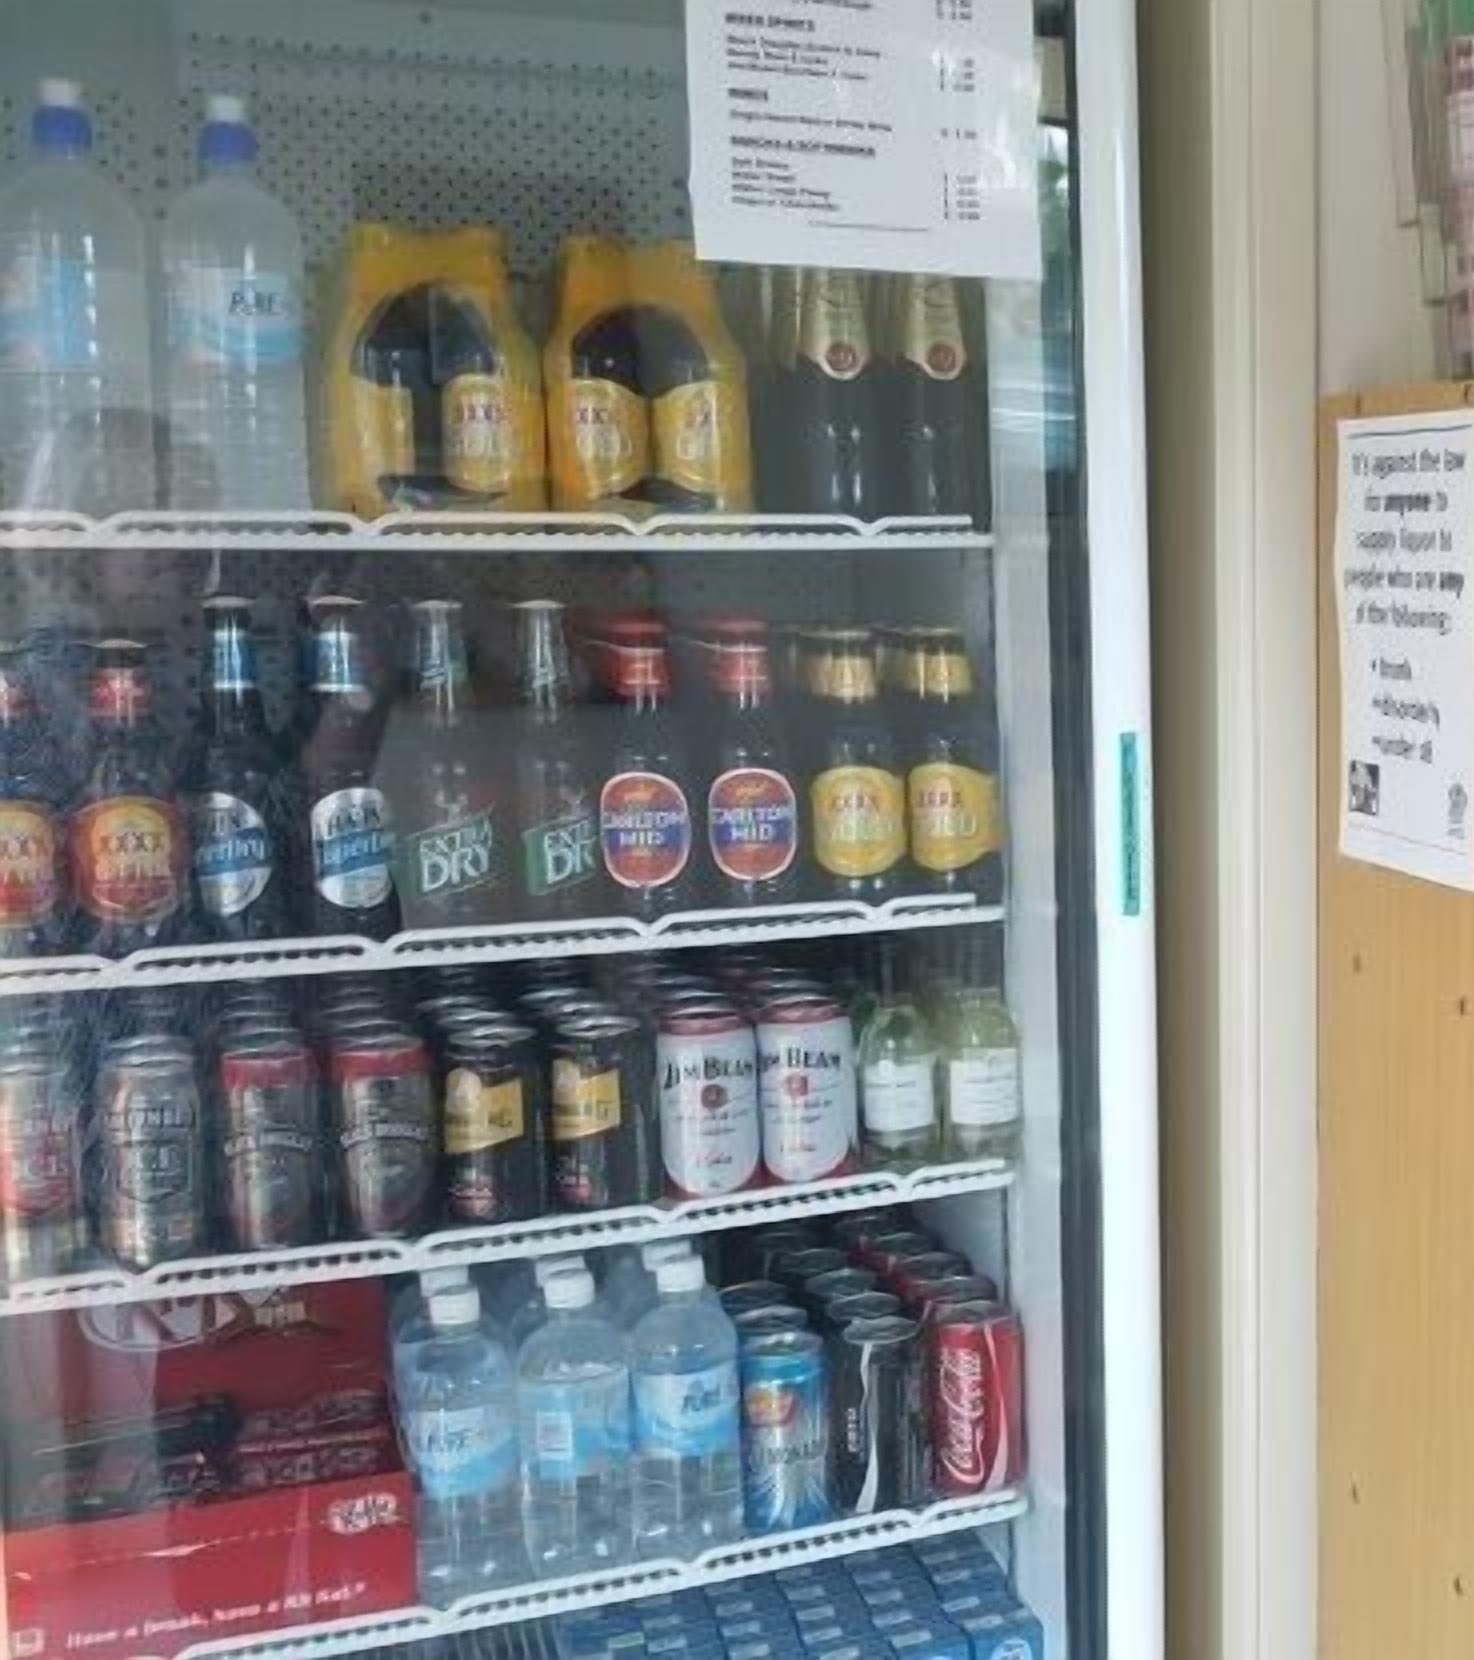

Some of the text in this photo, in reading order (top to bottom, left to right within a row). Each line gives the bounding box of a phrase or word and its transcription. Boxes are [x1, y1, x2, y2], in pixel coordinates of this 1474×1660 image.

[1371, 451, 1417, 480] against
[1418, 449, 1441, 473] the
[1443, 449, 1466, 473] law
[1384, 493, 1431, 517] anyone
[1434, 489, 1449, 512] to
[1355, 528, 1453, 555] supply liquor to
[1343, 564, 1465, 599] people who are any
[1366, 602, 1389, 625] the
[619, 830, 666, 849] MID
[730, 823, 774, 843] MID
[422, 841, 489, 893] DRY
[785, 1046, 842, 1070] BEAM
[67, 1631, 118, 1649] Have
[123, 1627, 138, 1638] a
[212, 1604, 261, 1622] have
[266, 1601, 280, 1613] a
